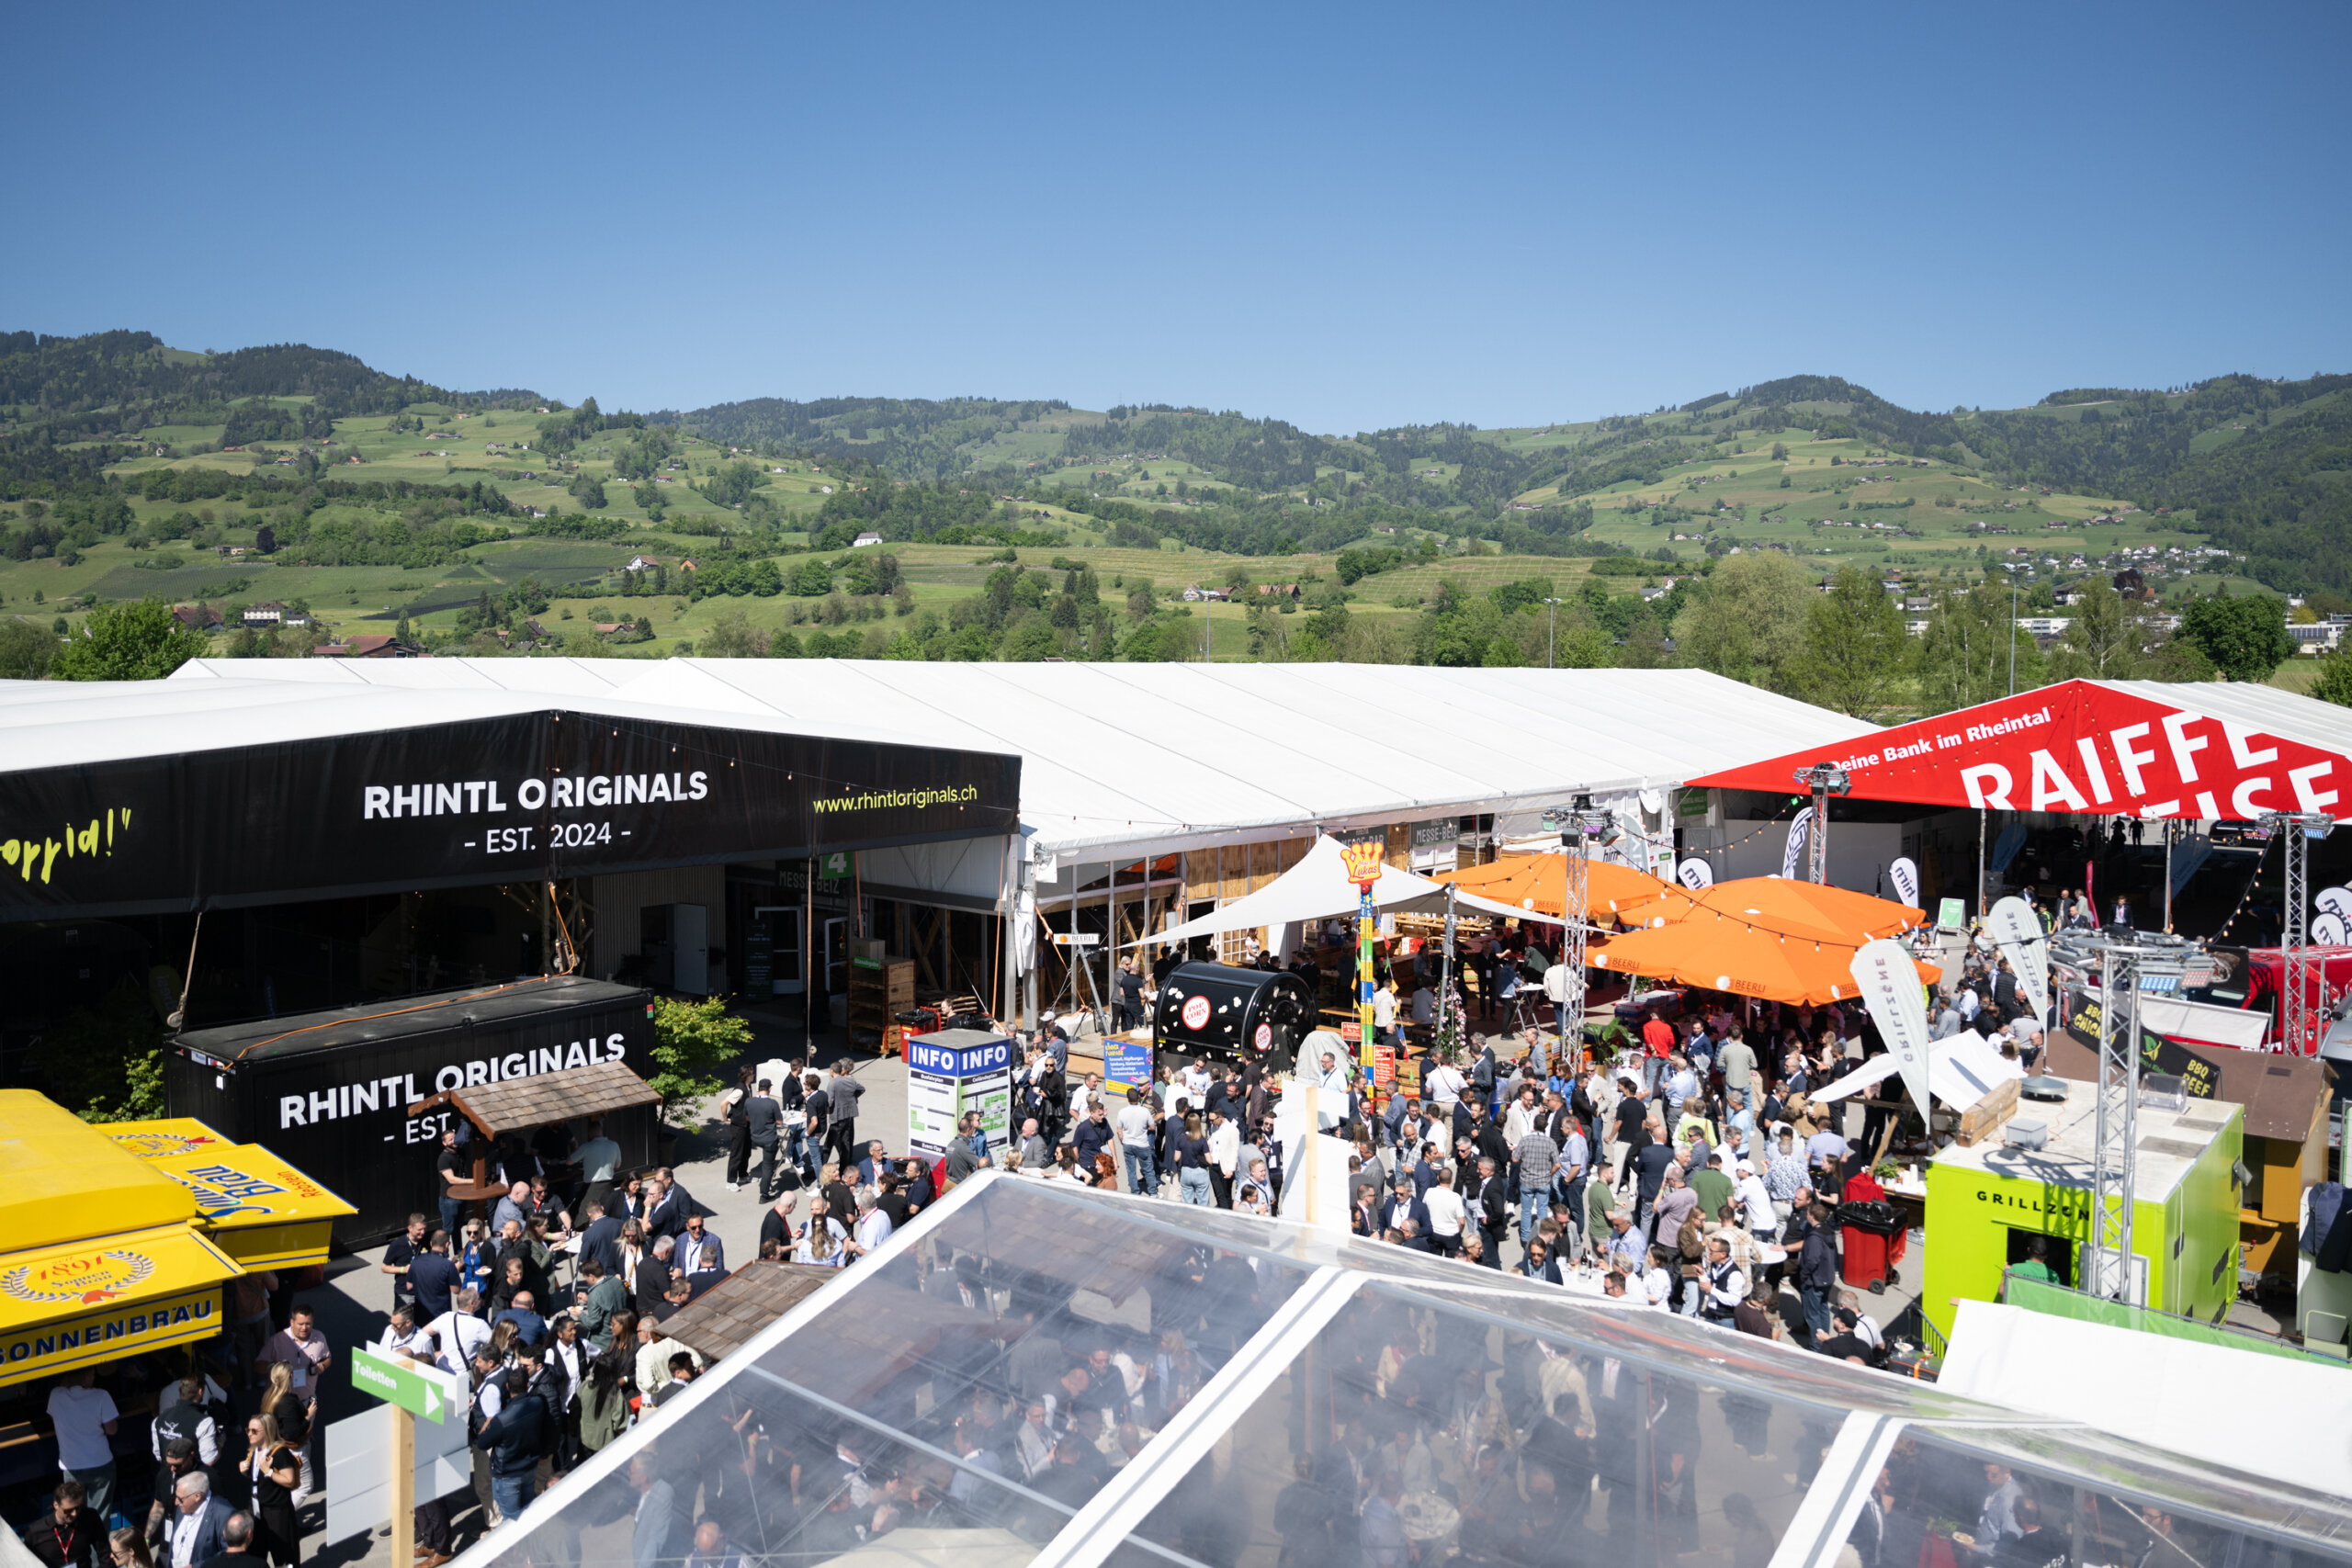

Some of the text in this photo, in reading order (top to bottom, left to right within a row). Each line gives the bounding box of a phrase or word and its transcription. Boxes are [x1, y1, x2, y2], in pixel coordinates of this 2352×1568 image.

[1883, 739, 1933, 762] Bank
[1936, 734, 1962, 749] im
[1965, 706, 2052, 742] Rheintal
[364, 771, 708, 819] RHINTL ORIGINALS
[813, 784, 978, 814] www.rhintloriginals.ch
[487, 828, 536, 853] EST.
[549, 822, 611, 848] 2024
[1417, 825, 1457, 843] MESSE-BEIZ
[828, 852, 847, 873] 4
[1352, 865, 1377, 878] Lukas
[1537, 900, 1561, 908] BEERLI
[1612, 958, 1640, 969] BEERLI
[1736, 980, 1766, 993] BEERLI
[1186, 1008, 1206, 1021] CORN
[1188, 1002, 1204, 1012] POP
[1257, 1033, 1269, 1043] CORN
[1258, 1028, 1267, 1037] POP
[912, 1045, 954, 1070] INFO
[962, 1045, 1007, 1070] INFO
[2187, 1059, 2209, 1078] BBQ
[280, 1032, 626, 1129] RHINTL ORIGINALS
[277, 1170, 323, 1199] Rebstein
[1977, 1190, 2090, 1221] GRILLZON
[40, 1256, 102, 1280] 1891
[354, 1359, 397, 1391] Toiletten
